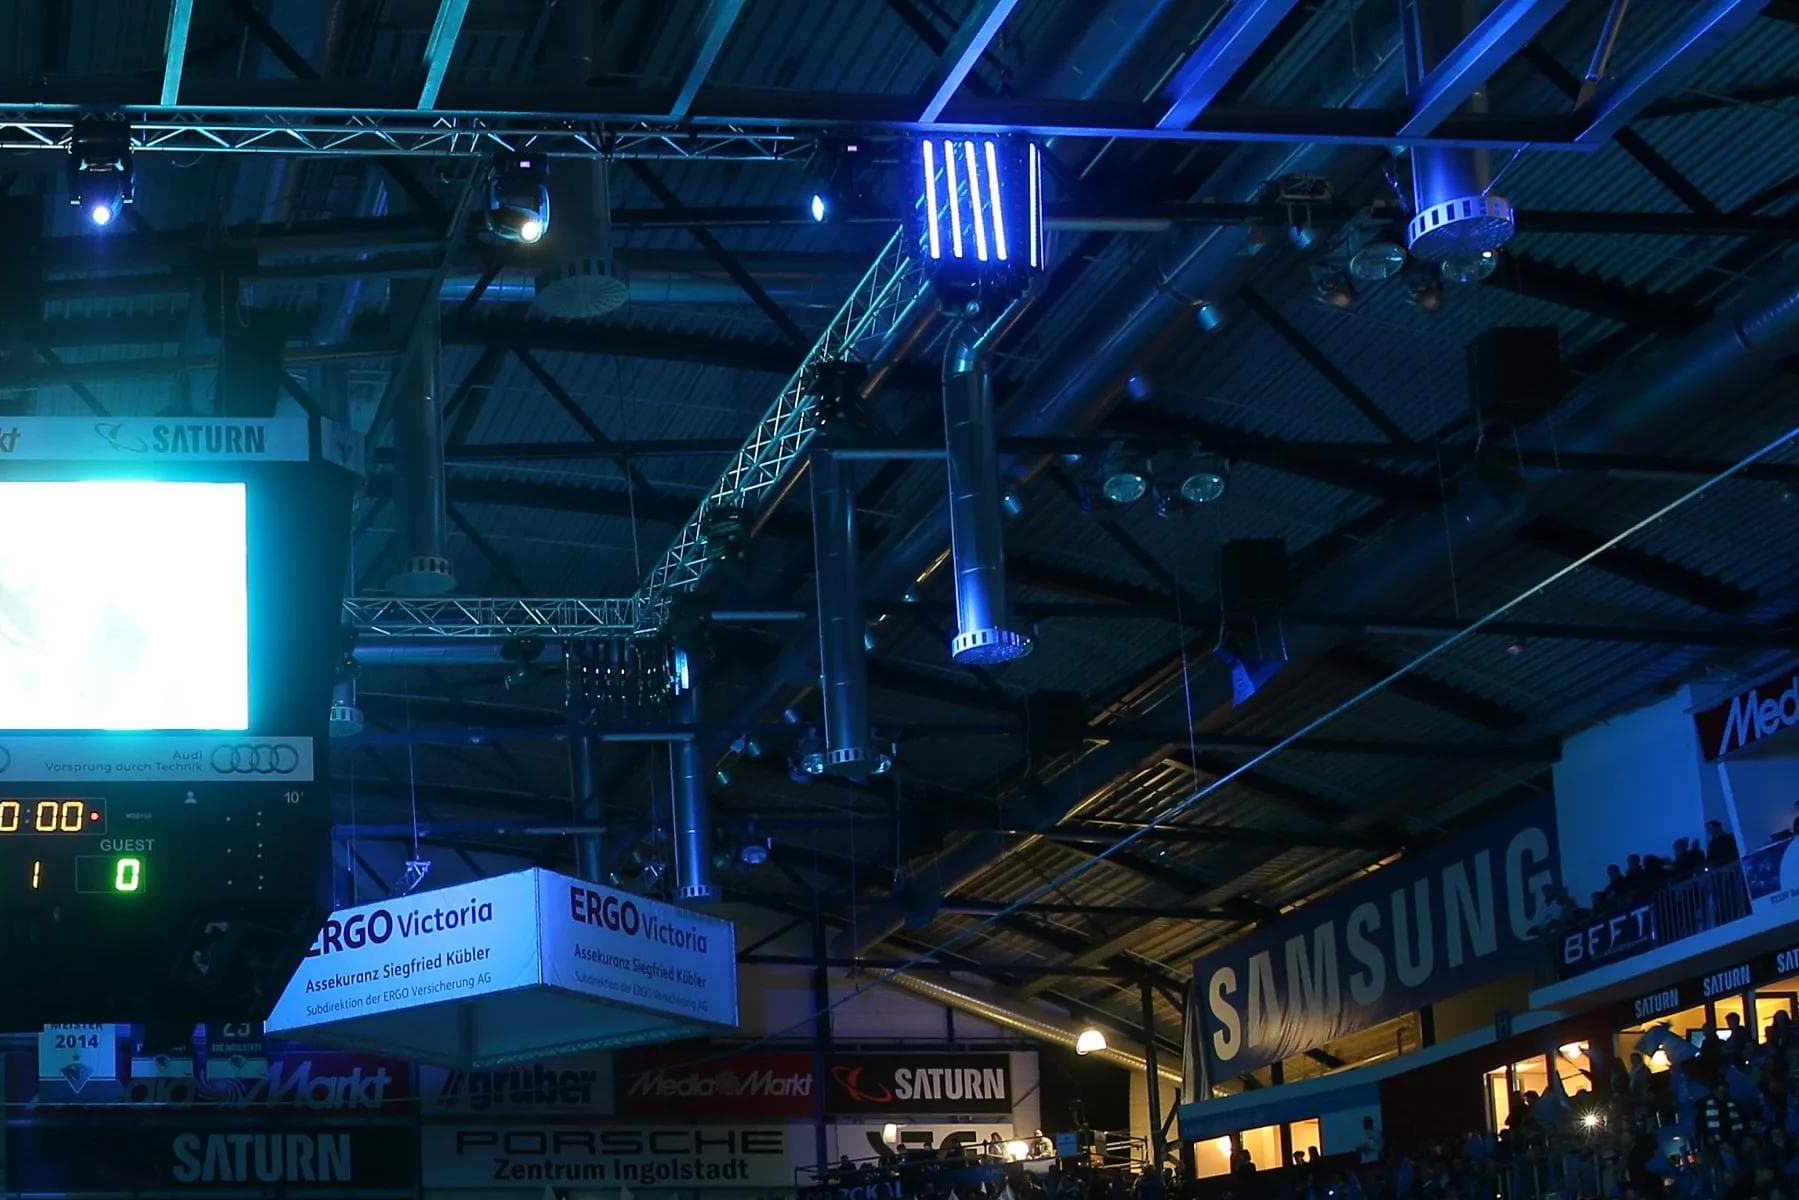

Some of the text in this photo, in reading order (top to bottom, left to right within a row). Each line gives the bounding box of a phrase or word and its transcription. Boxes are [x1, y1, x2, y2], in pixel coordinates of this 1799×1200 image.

[153, 424, 264, 454] SATURN
[45, 761, 202, 774] Vorsprung durch Technik
[173, 751, 202, 761] Audi
[100, 839, 155, 852] GUEST
[32, 860, 41, 889] 1
[115, 857, 141, 891] 0
[397, 898, 493, 940] Victoria
[570, 885, 707, 954] ERGO Victoria
[1207, 827, 1556, 1062] SAMSUNG
[306, 945, 490, 993] Assekuranz Siegfried Kübler
[574, 943, 630, 970] Assekuranz
[633, 958, 674, 982] Siegfried
[306, 972, 492, 1016] Subdirektion der ERGO Versicherung AG
[1703, 964, 1750, 997] SATURN
[1634, 987, 1679, 1018] SATURN
[55, 1034, 99, 1050] 2014
[259, 1061, 391, 1110] Markt
[625, 1070, 814, 1098] Media Markt
[894, 1067, 1005, 1101] SATURN
[171, 1132, 352, 1182] SATURN
[457, 1130, 783, 1155] PORSCHE
[494, 1158, 749, 1185] Zentrum Ingolstadt
